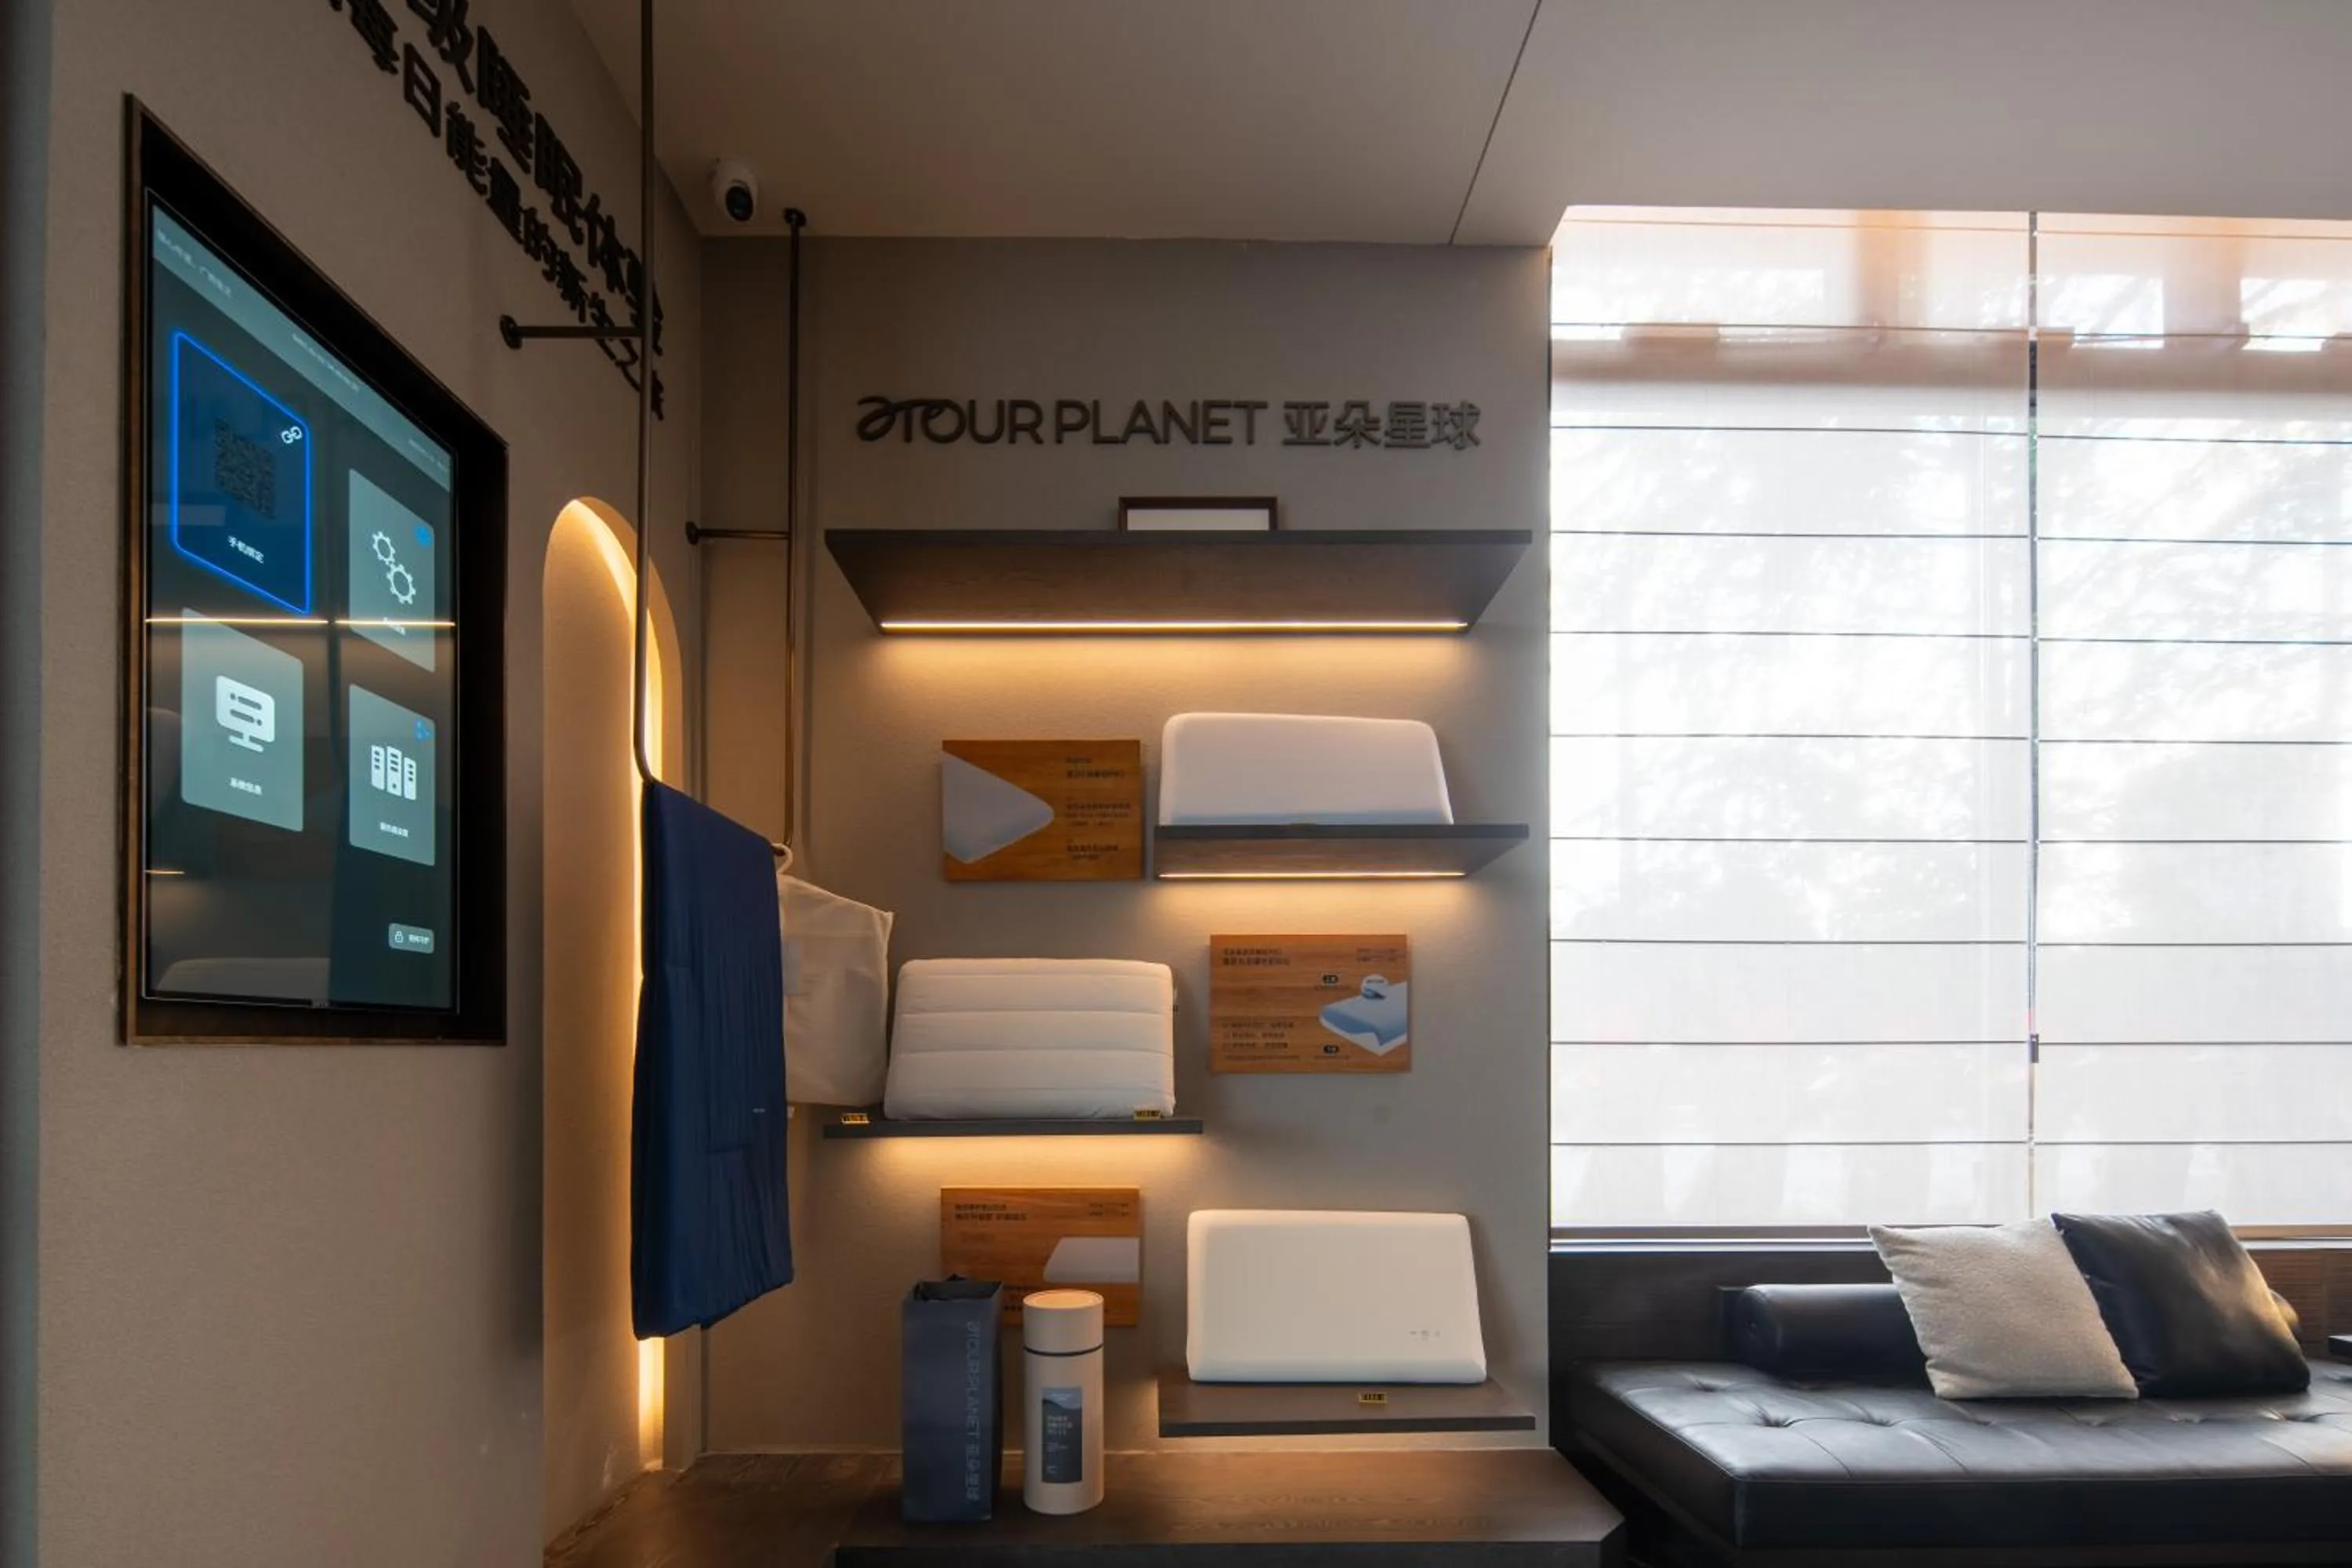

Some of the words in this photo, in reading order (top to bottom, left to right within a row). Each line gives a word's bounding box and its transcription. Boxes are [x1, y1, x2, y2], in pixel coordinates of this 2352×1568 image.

[1054, 399, 1269, 445] PLANET
[1282, 400, 1482, 451] 亚朵星球
